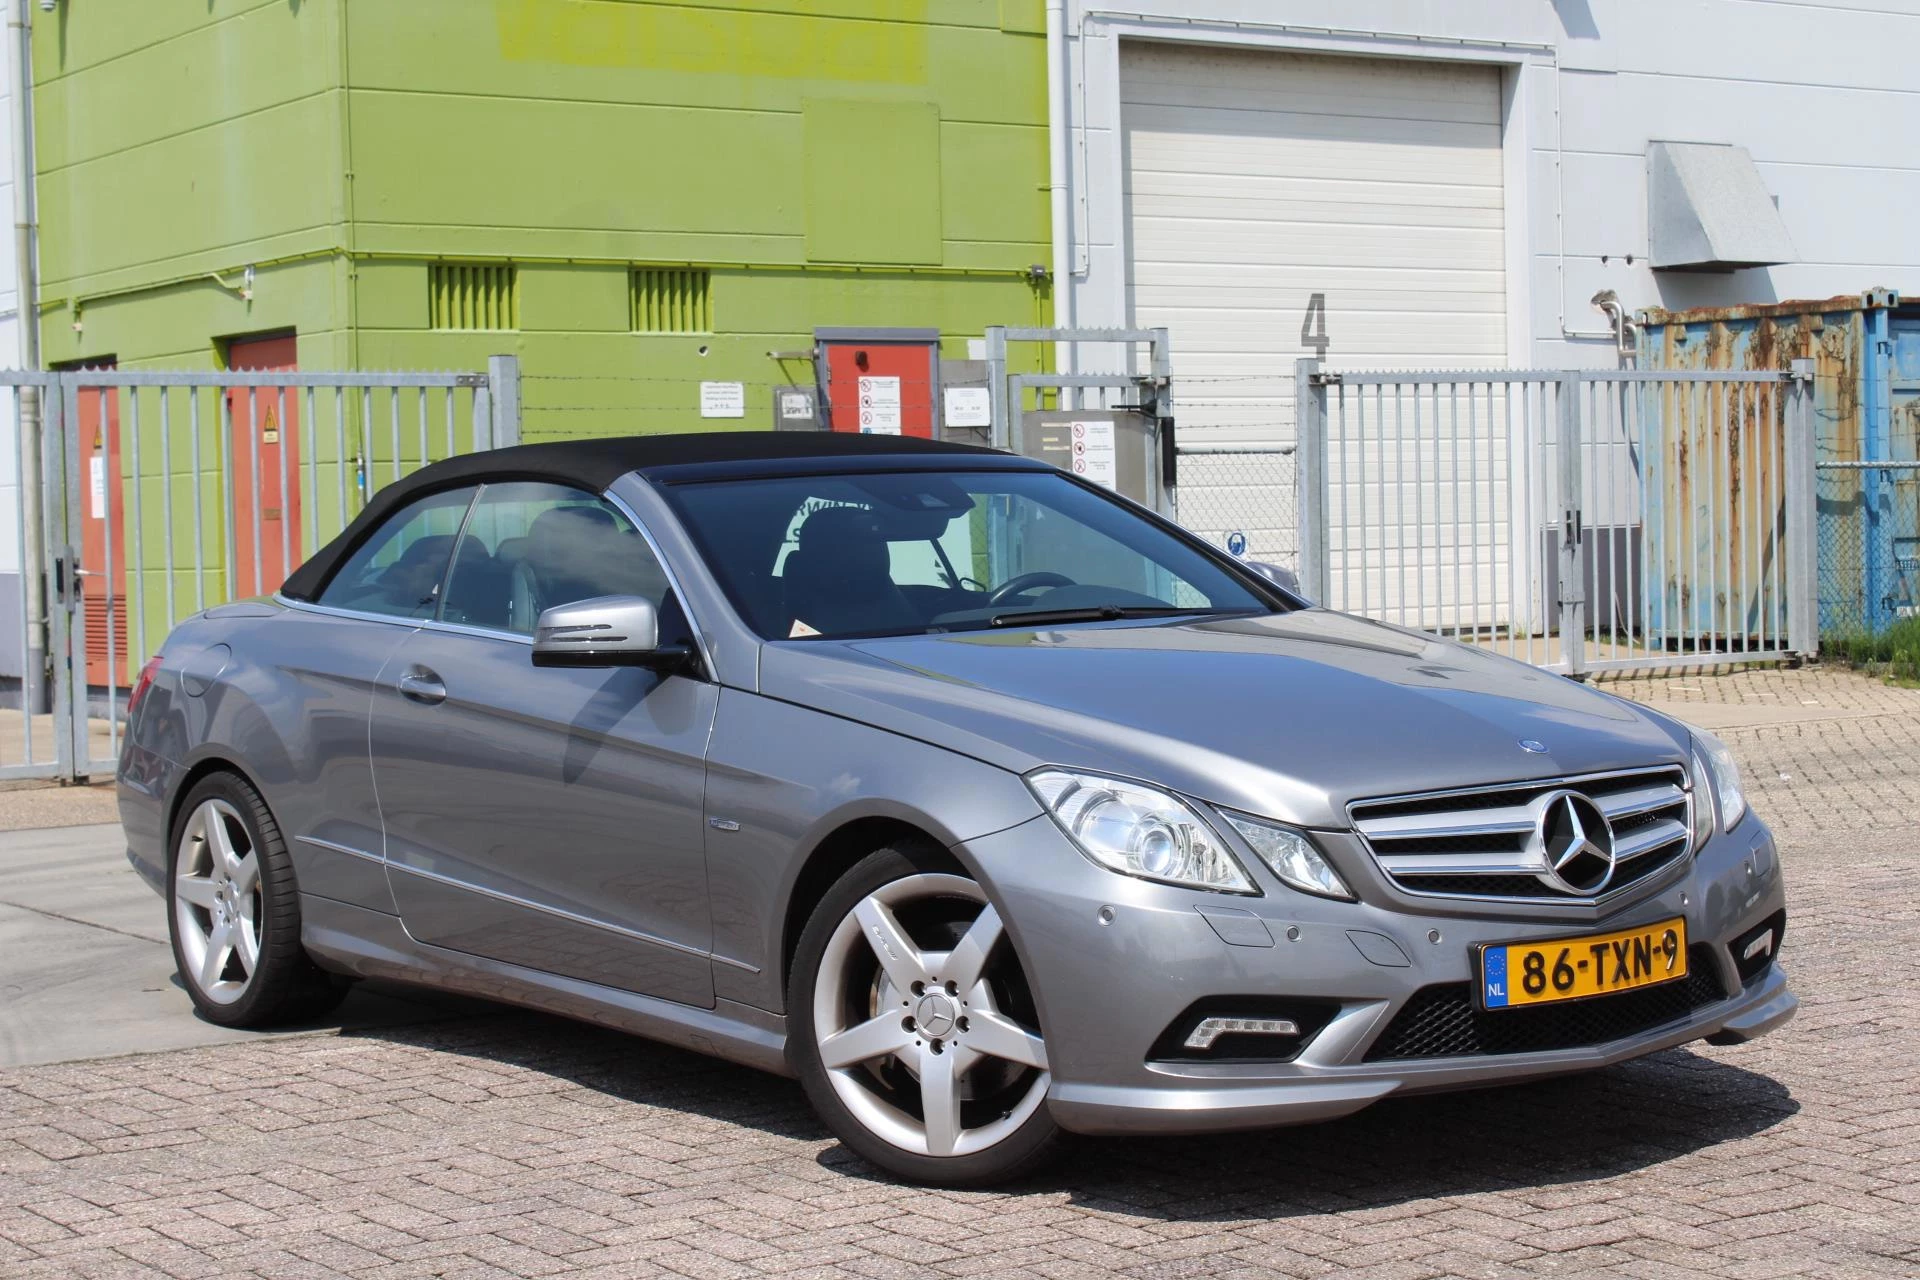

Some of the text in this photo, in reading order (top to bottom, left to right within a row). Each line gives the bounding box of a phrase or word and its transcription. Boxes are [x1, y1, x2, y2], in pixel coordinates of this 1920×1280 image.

[1301, 293, 1329, 363] 4
[1488, 983, 1504, 997] NL
[1522, 928, 1678, 995] 86-TXN-9
